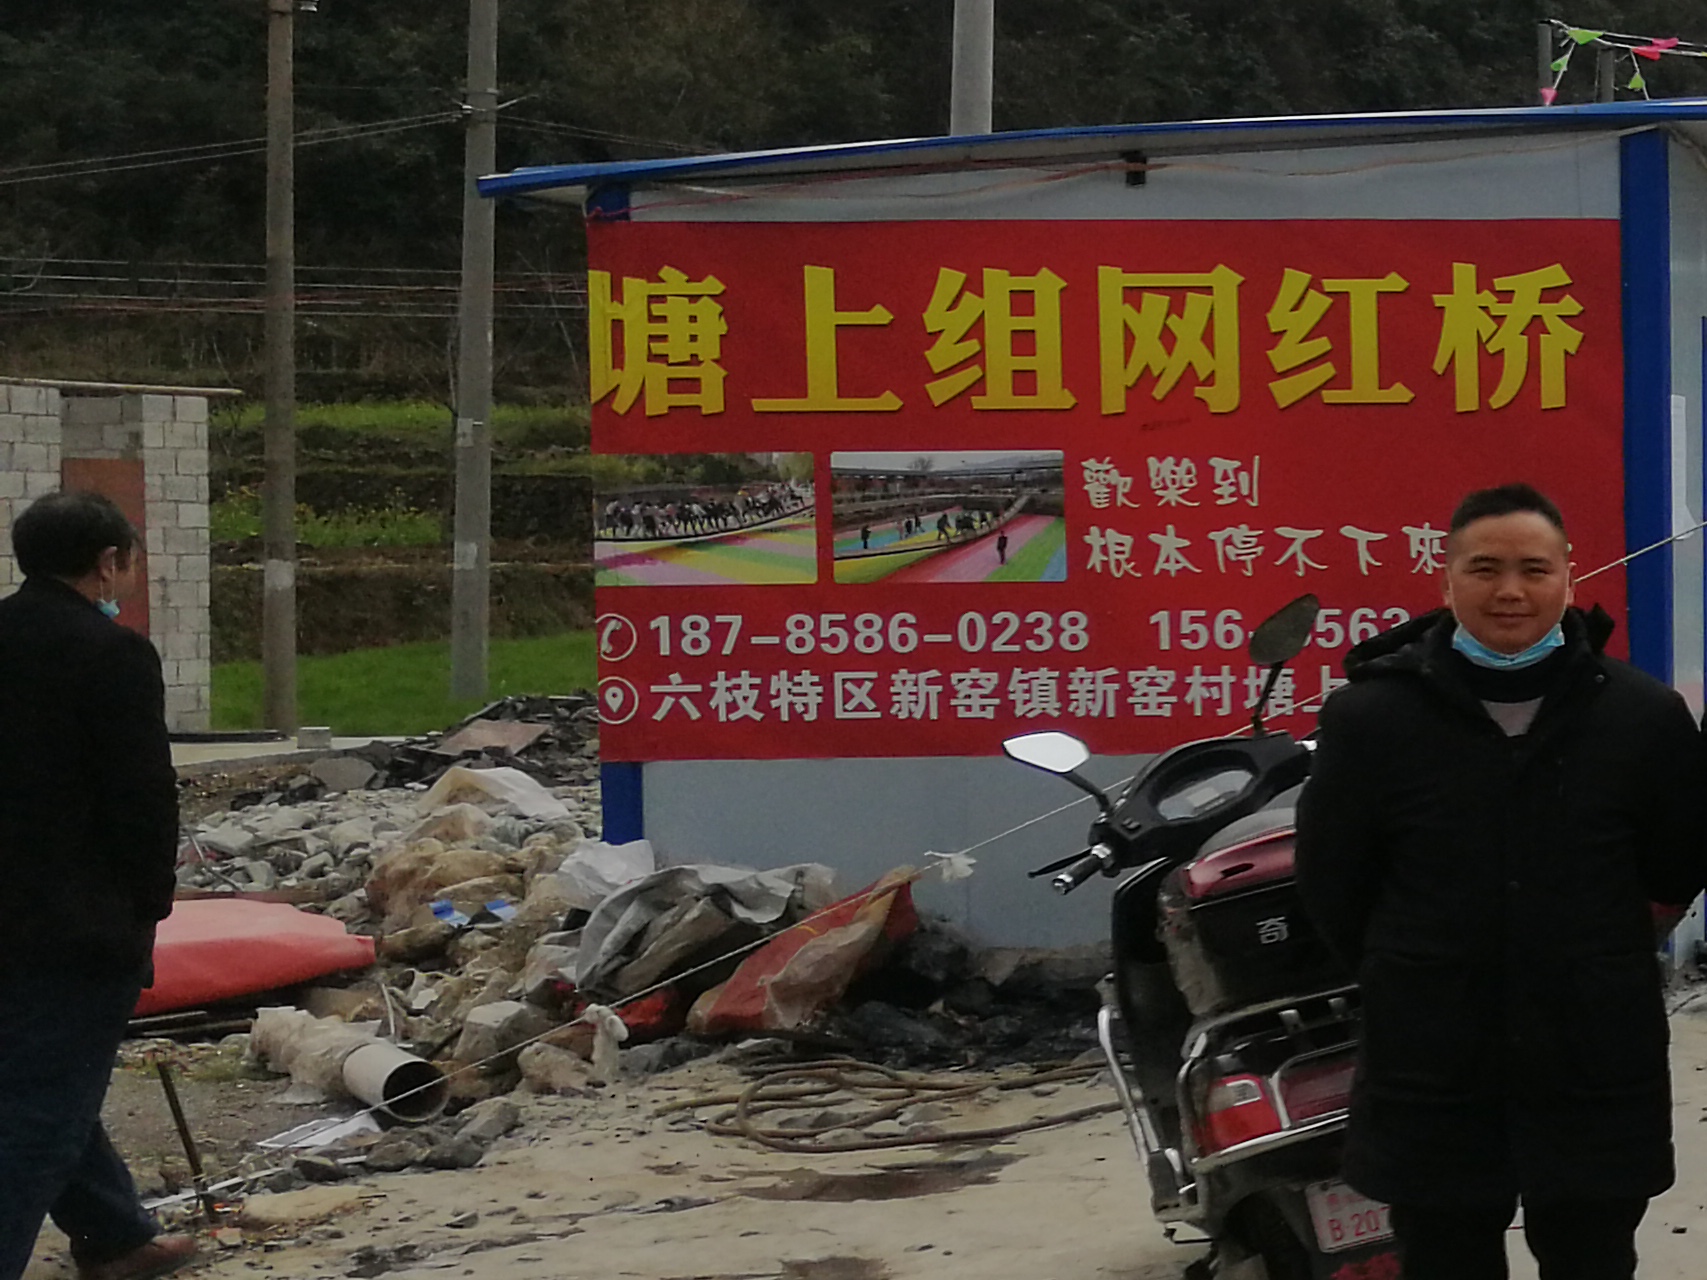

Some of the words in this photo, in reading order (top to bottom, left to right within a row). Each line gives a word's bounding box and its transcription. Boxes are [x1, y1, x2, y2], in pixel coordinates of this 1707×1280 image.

[588, 263, 1585, 416] 塘上组网红桥
[649, 610, 1090, 657] 187-8586-0238
[649, 665, 1347, 722] 六枝特区新窑镇新窑村塘上
